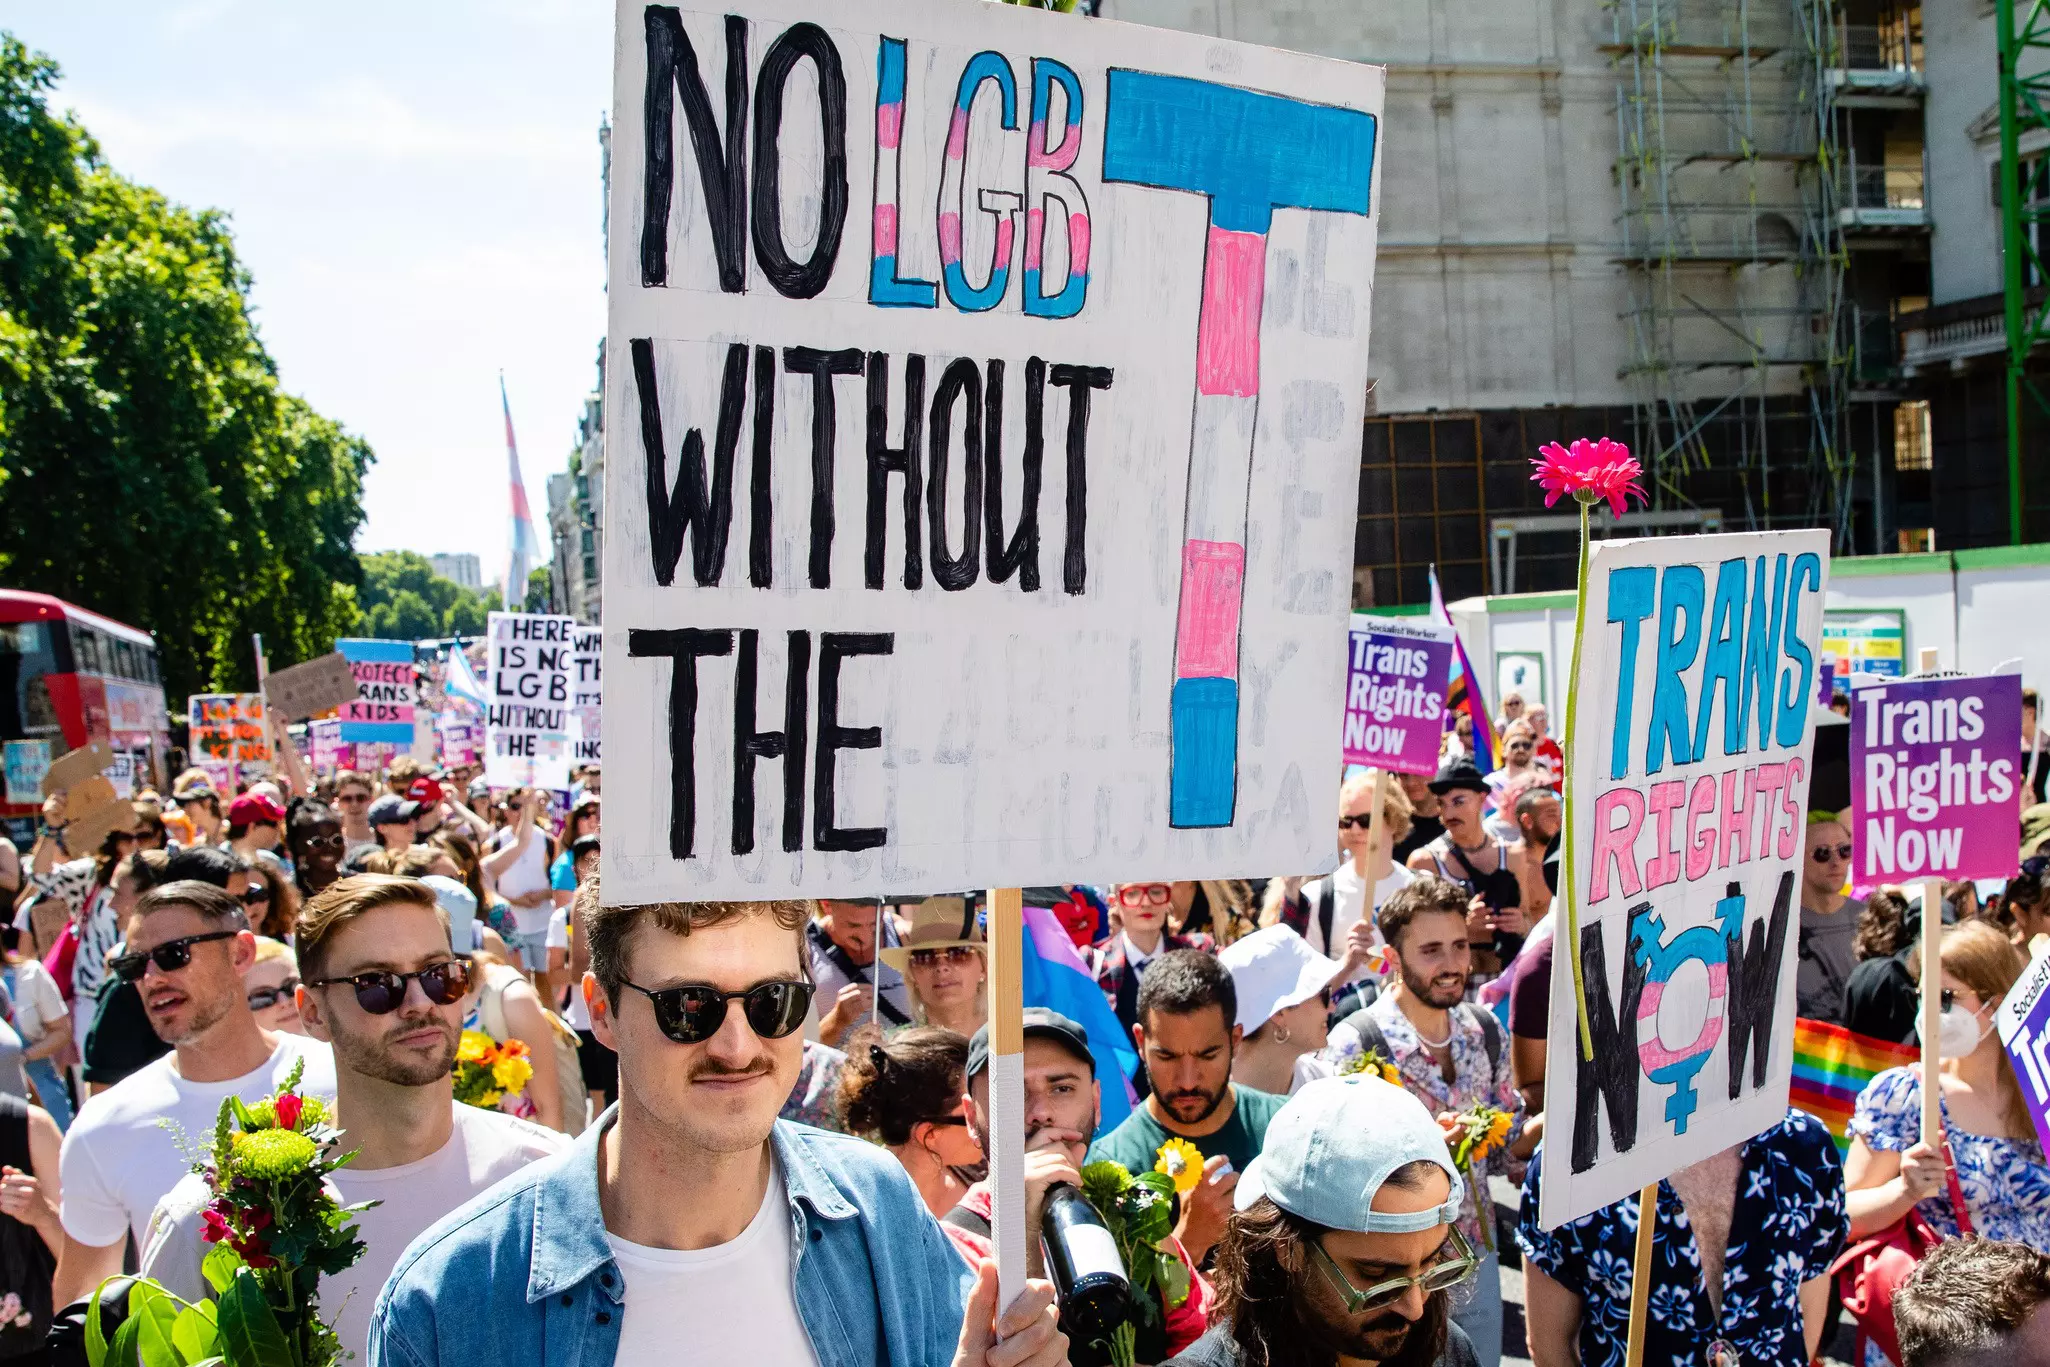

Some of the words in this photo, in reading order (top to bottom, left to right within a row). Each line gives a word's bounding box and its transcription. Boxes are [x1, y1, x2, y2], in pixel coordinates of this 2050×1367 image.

[641, 5, 848, 299] NO
[868, 34, 1091, 319] LGB
[630, 337, 1113, 596] WITHOUT
[1102, 66, 1377, 829] T
[493, 618, 573, 642] THERE
[1366, 622, 1404, 635] Socialist
[348, 661, 412, 684] ROTECT
[499, 645, 526, 668] IS
[1351, 633, 1429, 679] Trans
[1607, 552, 1821, 780] TRANS
[358, 684, 410, 702] RANS
[496, 671, 567, 701] LGB
[1349, 672, 1442, 723] Rights
[350, 703, 400, 721] KIDS
[489, 704, 568, 730] WITHOUT
[1344, 712, 1407, 755] Now
[1858, 686, 1985, 748] Trans
[493, 733, 537, 757] THE
[628, 627, 894, 859] THE
[1865, 747, 2014, 823] Rights
[1587, 756, 1805, 906] RIGHTS
[1865, 815, 1963, 877] Now
[2013, 964, 2049, 1021] Socialist
[1572, 870, 1795, 1175] NOW
